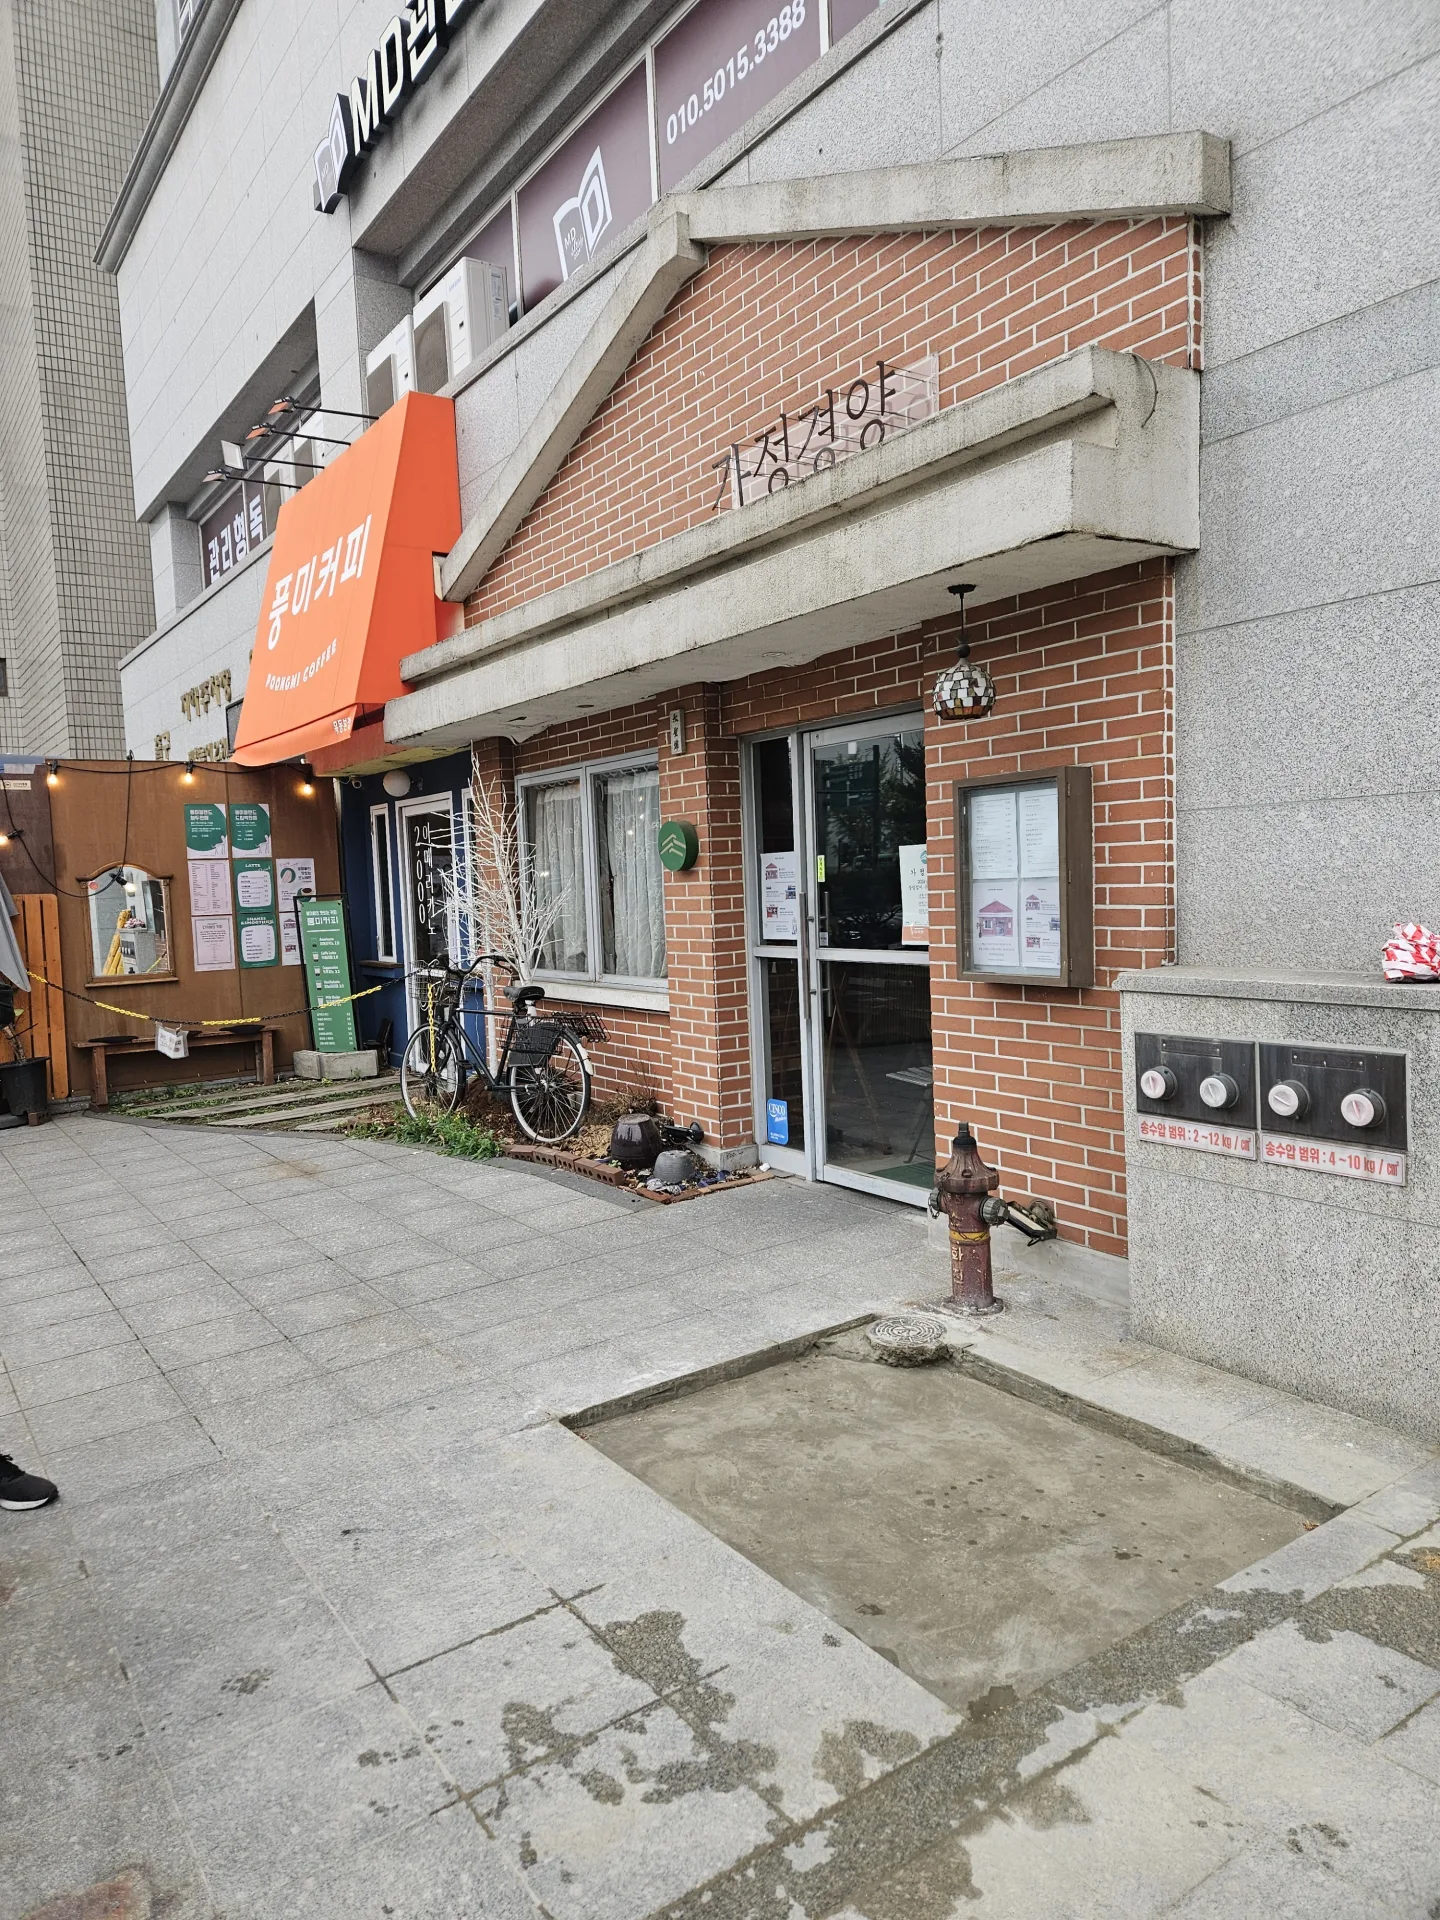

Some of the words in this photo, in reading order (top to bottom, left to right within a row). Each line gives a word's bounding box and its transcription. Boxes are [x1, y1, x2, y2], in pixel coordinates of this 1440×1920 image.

[667, 0, 806, 145] 010.5015.3388
[267, 513, 373, 651] 풍미커피
[265, 672, 302, 692] POONGMI
[303, 637, 338, 683] COFFEE
[413, 825, 426, 924] 2,000
[1140, 1121, 1166, 1137] 송수압
[1168, 1126, 1186, 1141] 범위
[1265, 1141, 1296, 1160] 송수압
[1299, 1146, 1320, 1164] 범위
